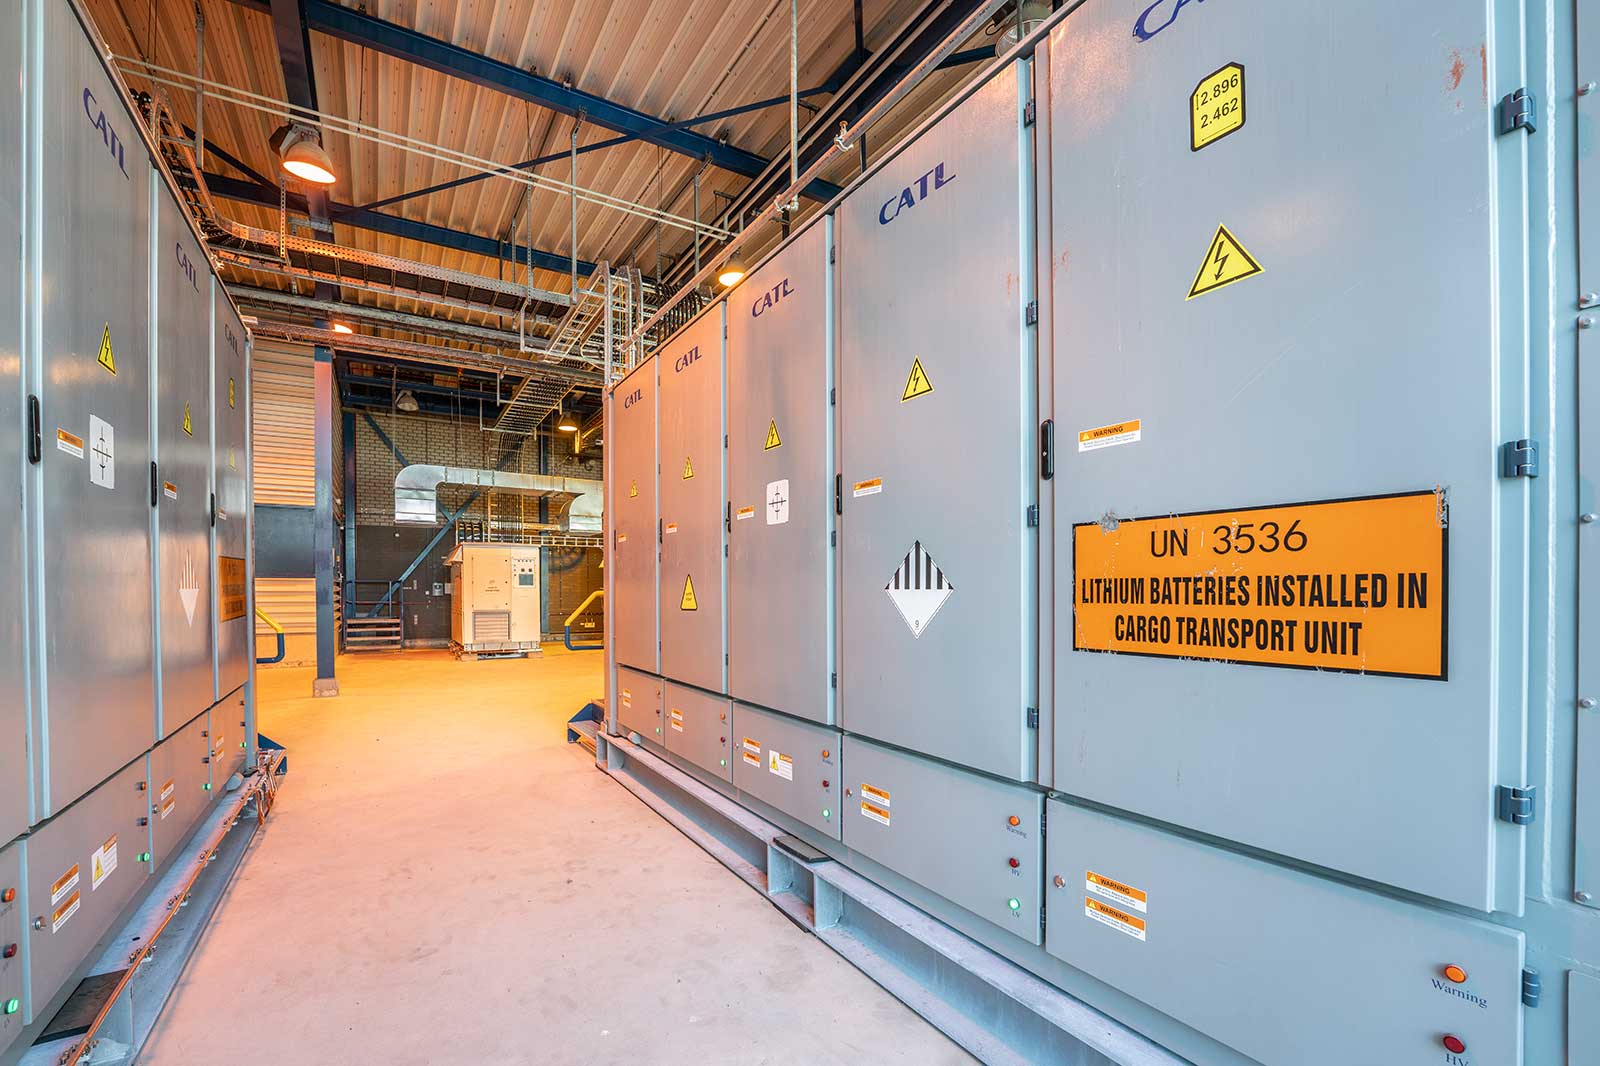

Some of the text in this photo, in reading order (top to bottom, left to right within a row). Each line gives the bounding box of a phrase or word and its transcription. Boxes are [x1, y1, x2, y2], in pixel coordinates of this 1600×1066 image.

[1200, 74, 1239, 106] 2.896
[1200, 97, 1239, 129] 2.462
[83, 88, 129, 181] CATL
[879, 161, 957, 225] CATL
[175, 242, 199, 293] CATL
[752, 278, 795, 318] CATL
[675, 344, 702, 373] CATL
[624, 388, 643, 409] CATL
[1093, 425, 1124, 437] WARNING
[1150, 519, 1308, 557] UN 3536
[1081, 573, 1427, 609] LITHIUM BATTERIES INSTALLED IN
[1115, 614, 1363, 656] CARGO TRANSPORT UNIT
[1100, 878, 1130, 895] WARNING
[1099, 904, 1129, 922] WARNING
[1431, 978, 1488, 1009] Warning
